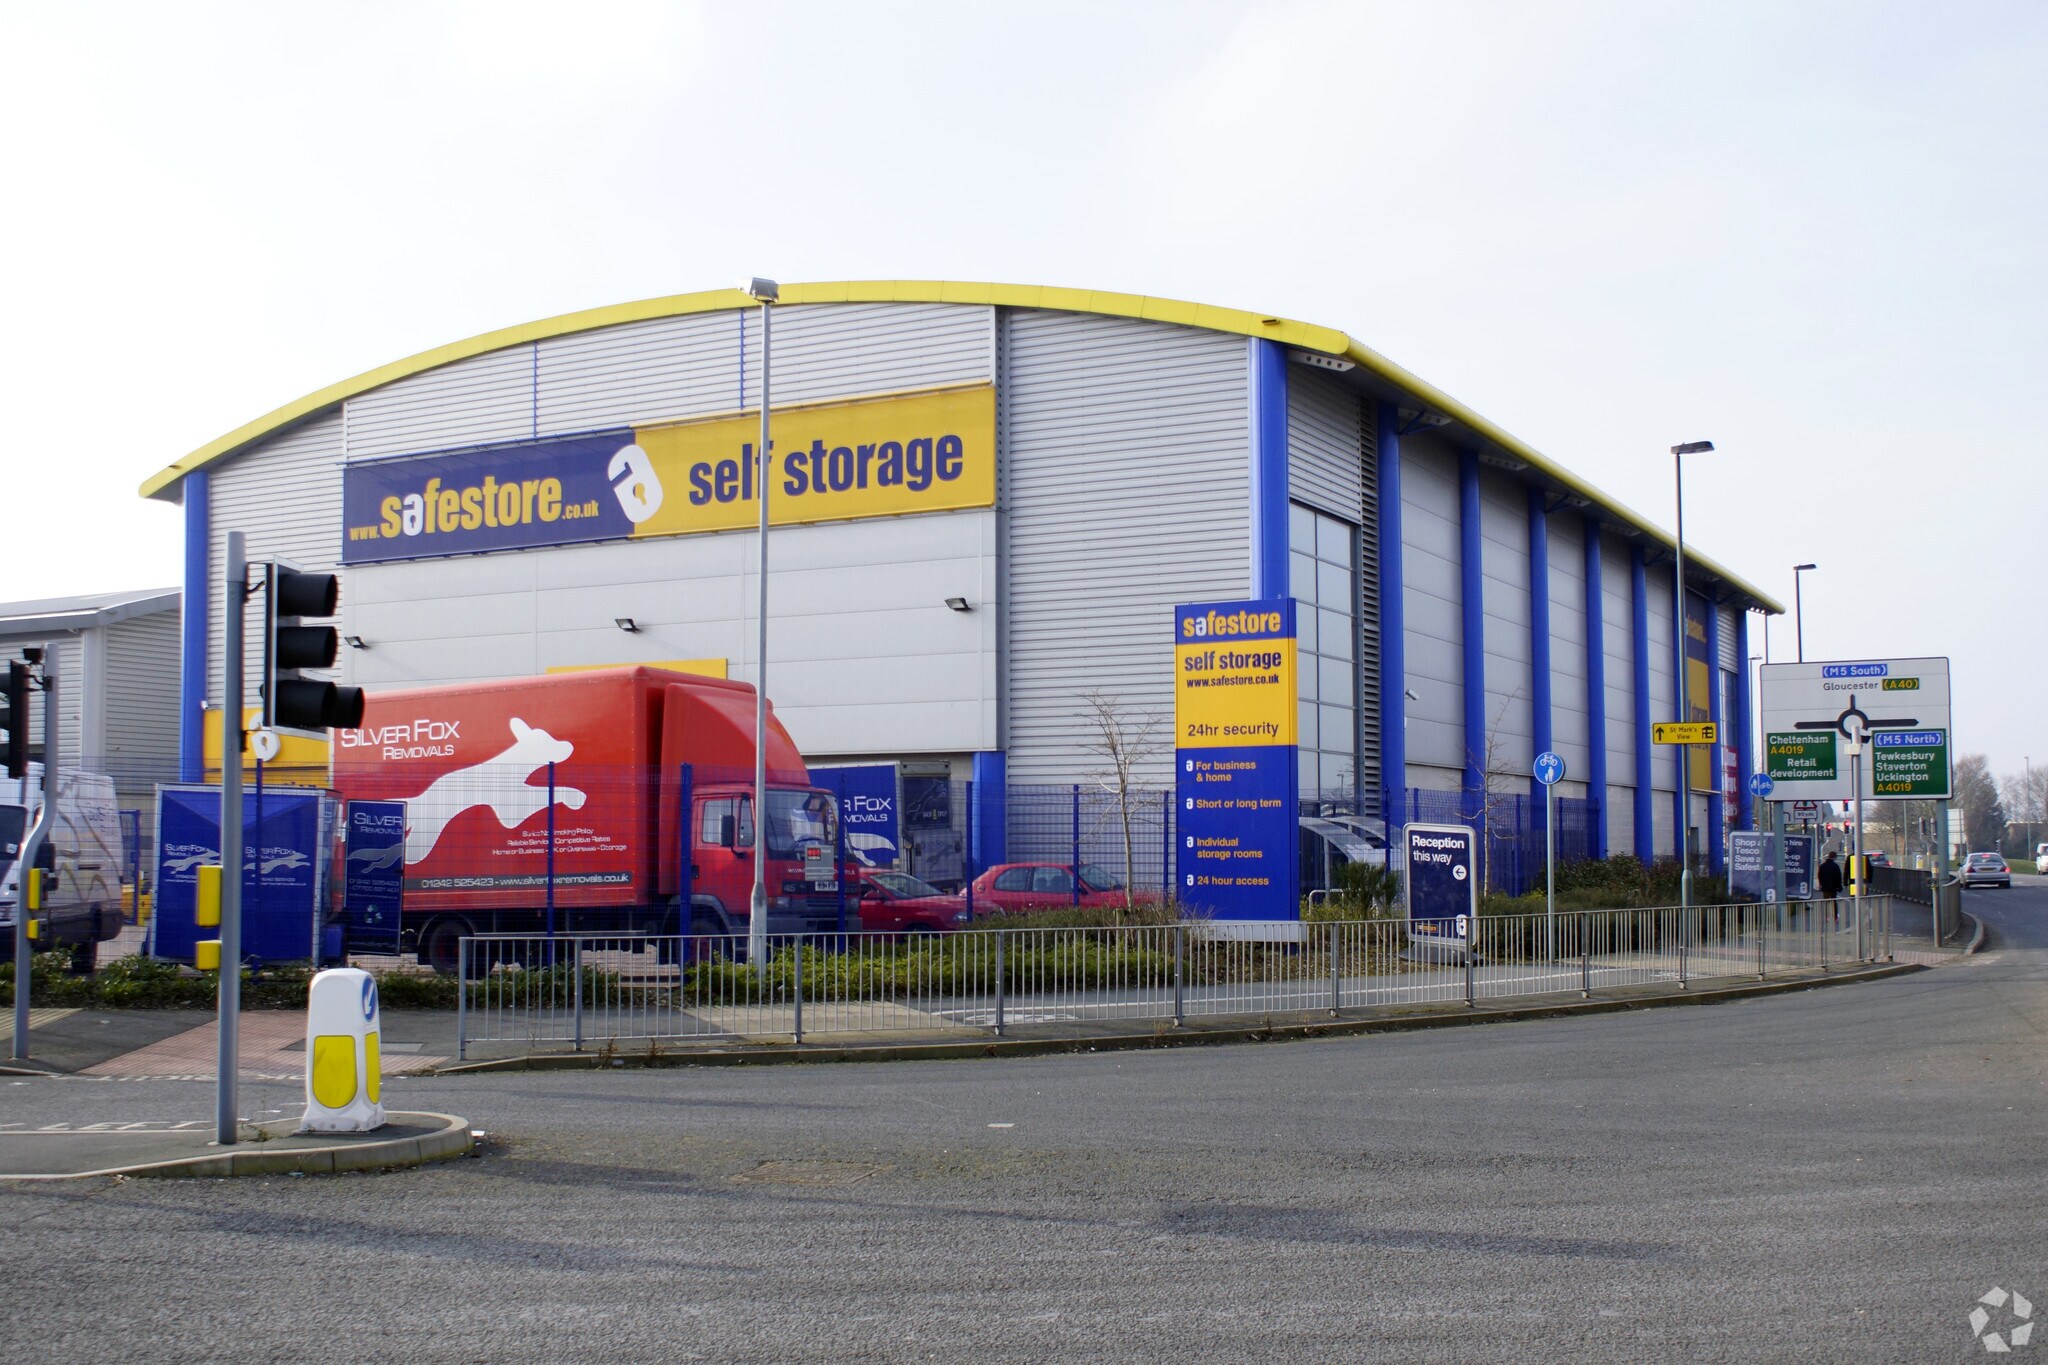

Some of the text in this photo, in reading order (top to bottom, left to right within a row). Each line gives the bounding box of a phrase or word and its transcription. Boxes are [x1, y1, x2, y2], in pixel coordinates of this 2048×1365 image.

[783, 434, 963, 499] storage
[1183, 610, 1281, 637] safestore
[1185, 651, 1282, 672] self storage
[1186, 674, 1279, 687] www.safestore.co.uk
[1823, 681, 1878, 691] Gloucester
[1188, 722, 1279, 737] 24hr security
[1769, 735, 1829, 745] Cheltenham
[1770, 745, 1804, 754] A4019
[1875, 752, 1935, 762] Tewkesbury
[1196, 760, 1257, 770] For business
[1787, 758, 1817, 767] Retail
[1876, 762, 1927, 771] Staverton
[1196, 773, 1232, 782] & home
[1769, 769, 1834, 779] development
[1876, 772, 1929, 782] Uckington
[1877, 783, 1912, 792] A4019
[1196, 799, 1222, 808] Short
[1237, 799, 1257, 810] long
[1260, 799, 1282, 808] term
[553, 829, 576, 837] moking
[1196, 838, 1239, 847] Individual
[1412, 835, 1465, 849] Reception
[1734, 839, 1756, 848] Shop
[1197, 850, 1263, 860] storage rooms
[1413, 850, 1452, 866] this way
[1734, 855, 1755, 863] Save
[1734, 863, 1774, 872] Safestre
[422, 879, 454, 888] 01242
[454, 878, 494, 887] 525423
[500, 872, 629, 886] www.silverfxremovals.co.uk
[1197, 876, 1270, 885] 24 hour access
